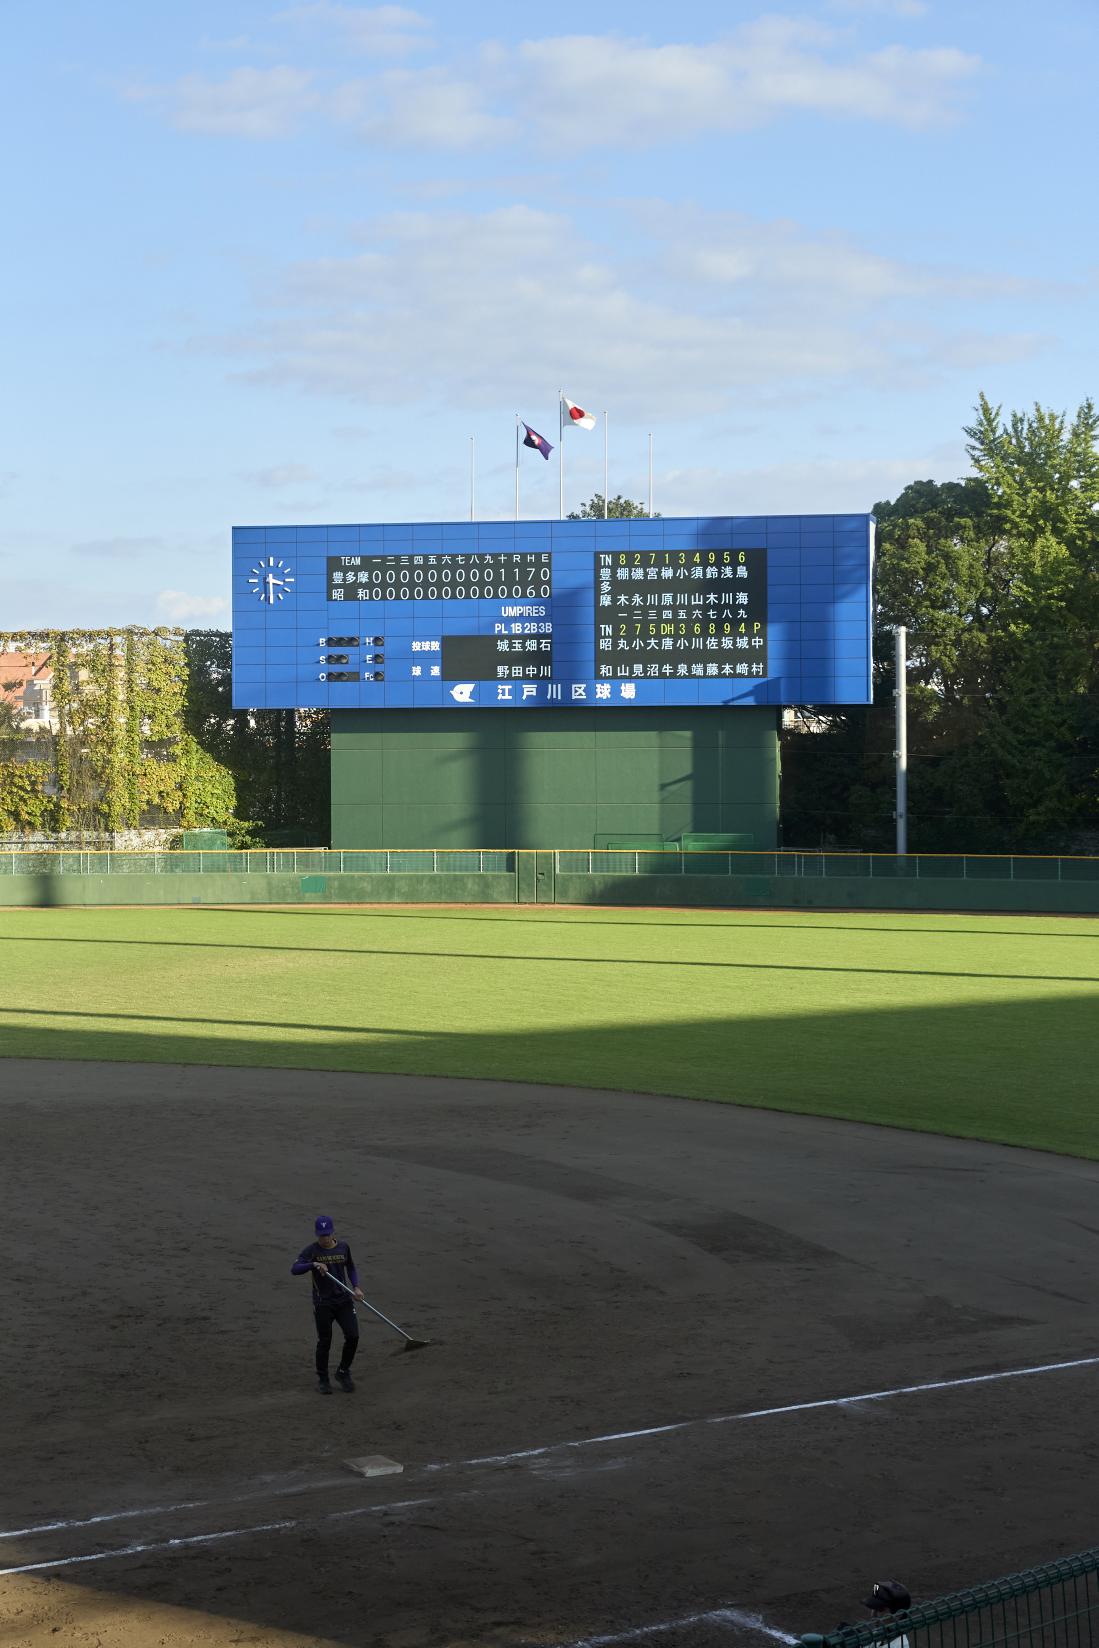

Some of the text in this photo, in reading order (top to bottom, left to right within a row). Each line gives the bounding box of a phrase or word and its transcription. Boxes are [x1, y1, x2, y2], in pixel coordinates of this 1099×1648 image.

[341, 557, 360, 565] TEAM
[414, 556, 423, 564] 四
[428, 556, 437, 564] 五
[442, 555, 451, 564] 六
[456, 555, 465, 564] 七
[470, 555, 479, 563] 八
[484, 554, 493, 563] 九
[498, 554, 507, 563] 十
[542, 554, 549, 562] E
[600, 552, 745, 565] TN 8 2 7 1 3 4 9 5 6
[332, 568, 549, 583] 豊多摩 0 0 0 0 0 0 0 0 0 1 1 7 0
[600, 568, 611, 606] 豊多摩
[373, 588, 381, 600] 0
[387, 588, 395, 600] 0
[401, 588, 409, 599] 0
[415, 587, 423, 599] 0
[428, 587, 437, 599] 0
[442, 587, 451, 599] 0
[456, 586, 465, 599] 0
[470, 586, 479, 598] 0
[485, 586, 493, 598] 0
[499, 586, 507, 598] 0
[513, 586, 521, 598] 0
[527, 585, 535, 597] 6
[541, 585, 549, 597] 0
[502, 606, 545, 616] UMPIRES
[648, 611, 657, 619] 三
[663, 610, 672, 619] 四
[678, 610, 687, 618] 五
[692, 610, 702, 619] 六
[707, 609, 717, 618] 七
[722, 610, 732, 618] 八
[738, 609, 747, 618] 九
[495, 623, 552, 633] PL 1B 2B 3B
[600, 623, 760, 636] TN 2 7 5 DH 3 6 8 9 4 P
[320, 638, 325, 646] B
[366, 637, 373, 645] H
[320, 656, 325, 664] S
[366, 655, 372, 663] E
[497, 683, 636, 700] 江戸川区球場
